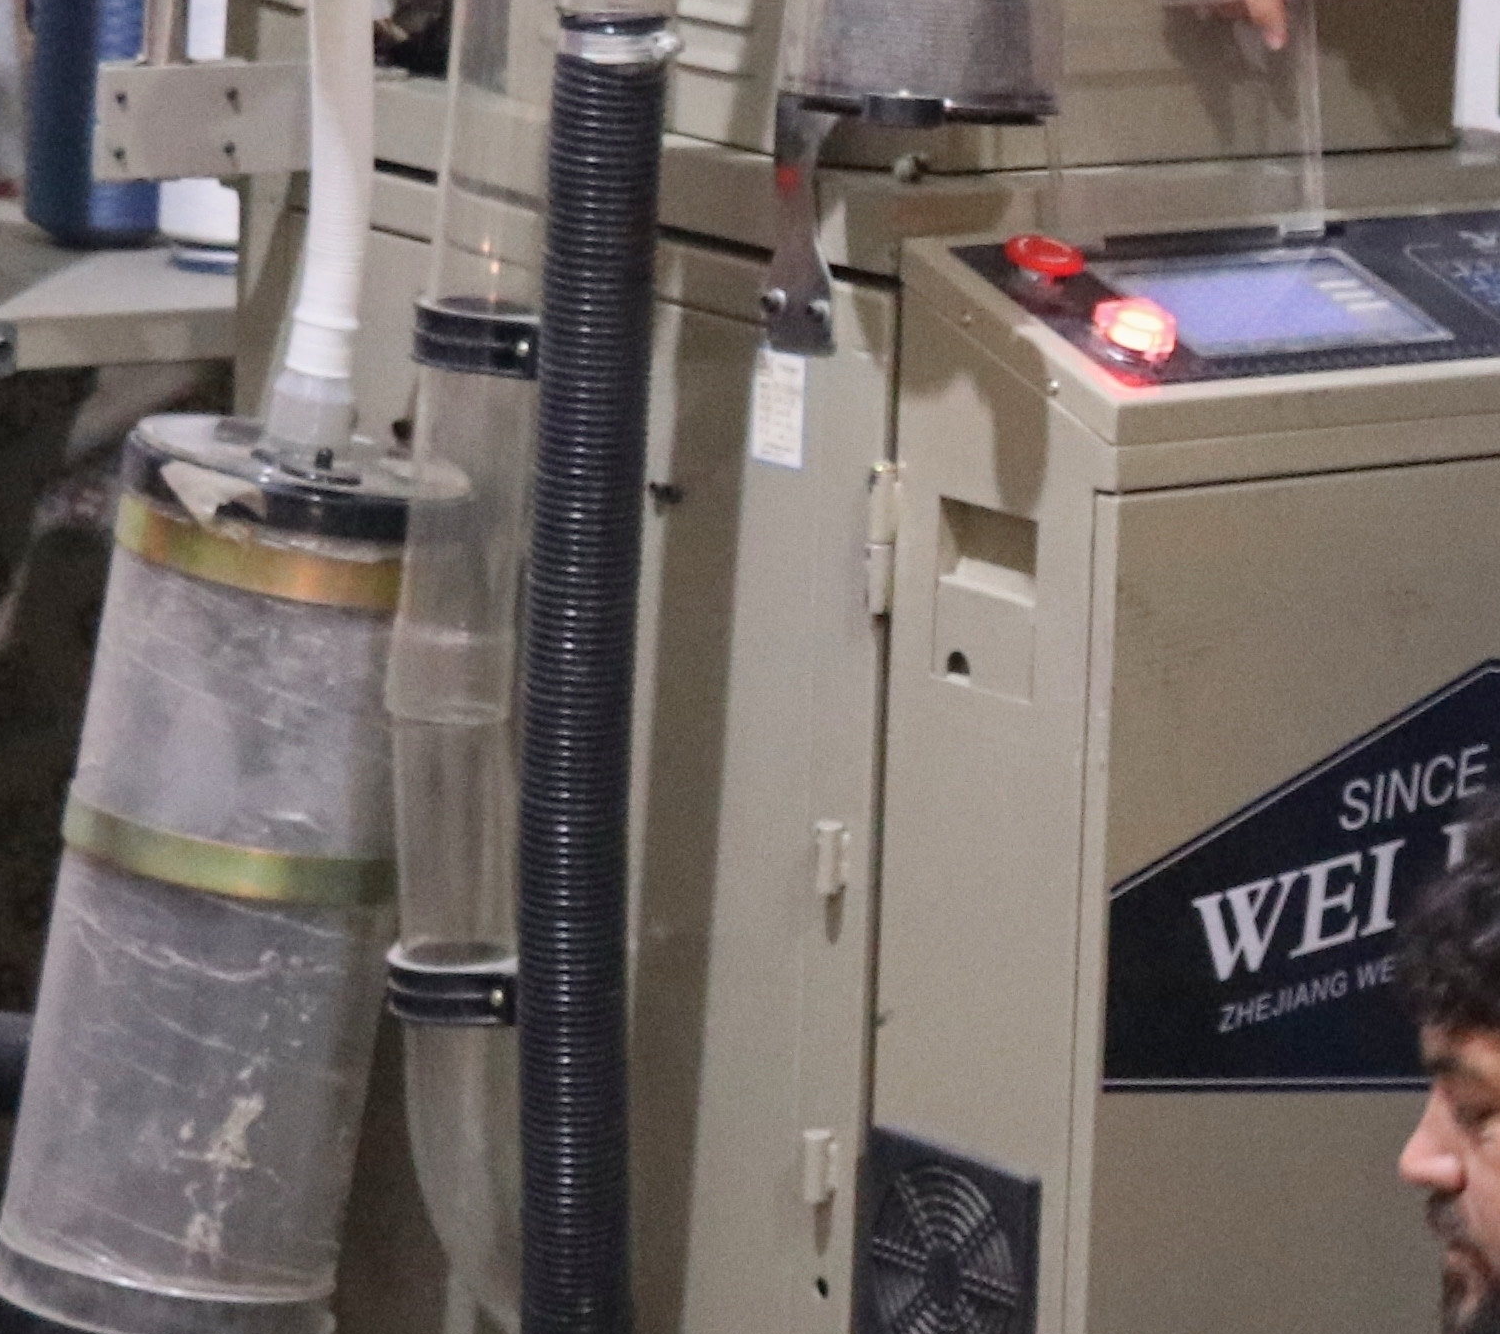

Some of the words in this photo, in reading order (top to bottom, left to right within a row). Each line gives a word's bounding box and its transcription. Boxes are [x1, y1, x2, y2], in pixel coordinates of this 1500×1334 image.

[1338, 743, 1491, 831] SINCE
[1191, 839, 1406, 983] WEI
[1218, 971, 1349, 1034] ZHEJIANG
